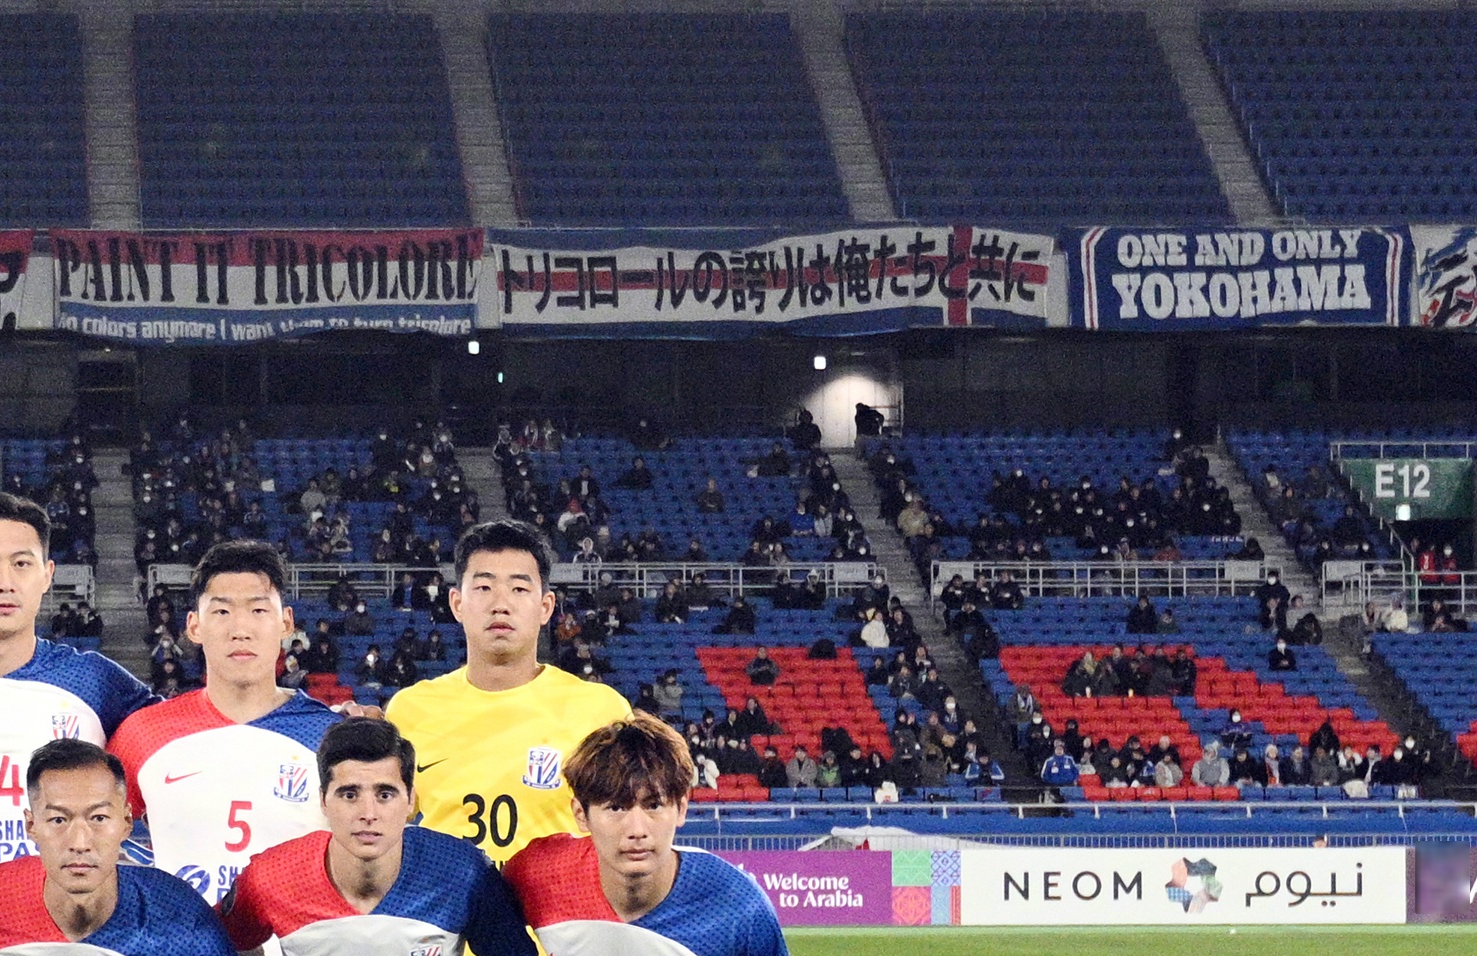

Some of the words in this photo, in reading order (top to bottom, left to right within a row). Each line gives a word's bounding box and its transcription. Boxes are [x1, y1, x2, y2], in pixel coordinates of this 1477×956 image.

[57, 237, 180, 302] PAINT
[195, 241, 236, 304] IT
[248, 233, 480, 305] TRICOLORE
[1117, 233, 1187, 268] ONE
[1195, 231, 1265, 267] AND
[1272, 229, 1362, 260] ONLY
[499, 231, 1041, 315] トリコロールの誇りは俺たちと共に
[1111, 264, 1371, 320] YOKOHAMA
[82, 316, 138, 338] colors
[141, 320, 216, 343] anymore
[230, 321, 275, 341] want
[1375, 464, 1431, 498] E12
[225, 800, 253, 853] 5
[462, 793, 518, 848] 30
[763, 873, 850, 891] Welcome
[779, 891, 799, 908] to
[803, 890, 863, 908] Arabia
[1003, 870, 1143, 901] NEOM
[1244, 862, 1364, 908] نيوم
